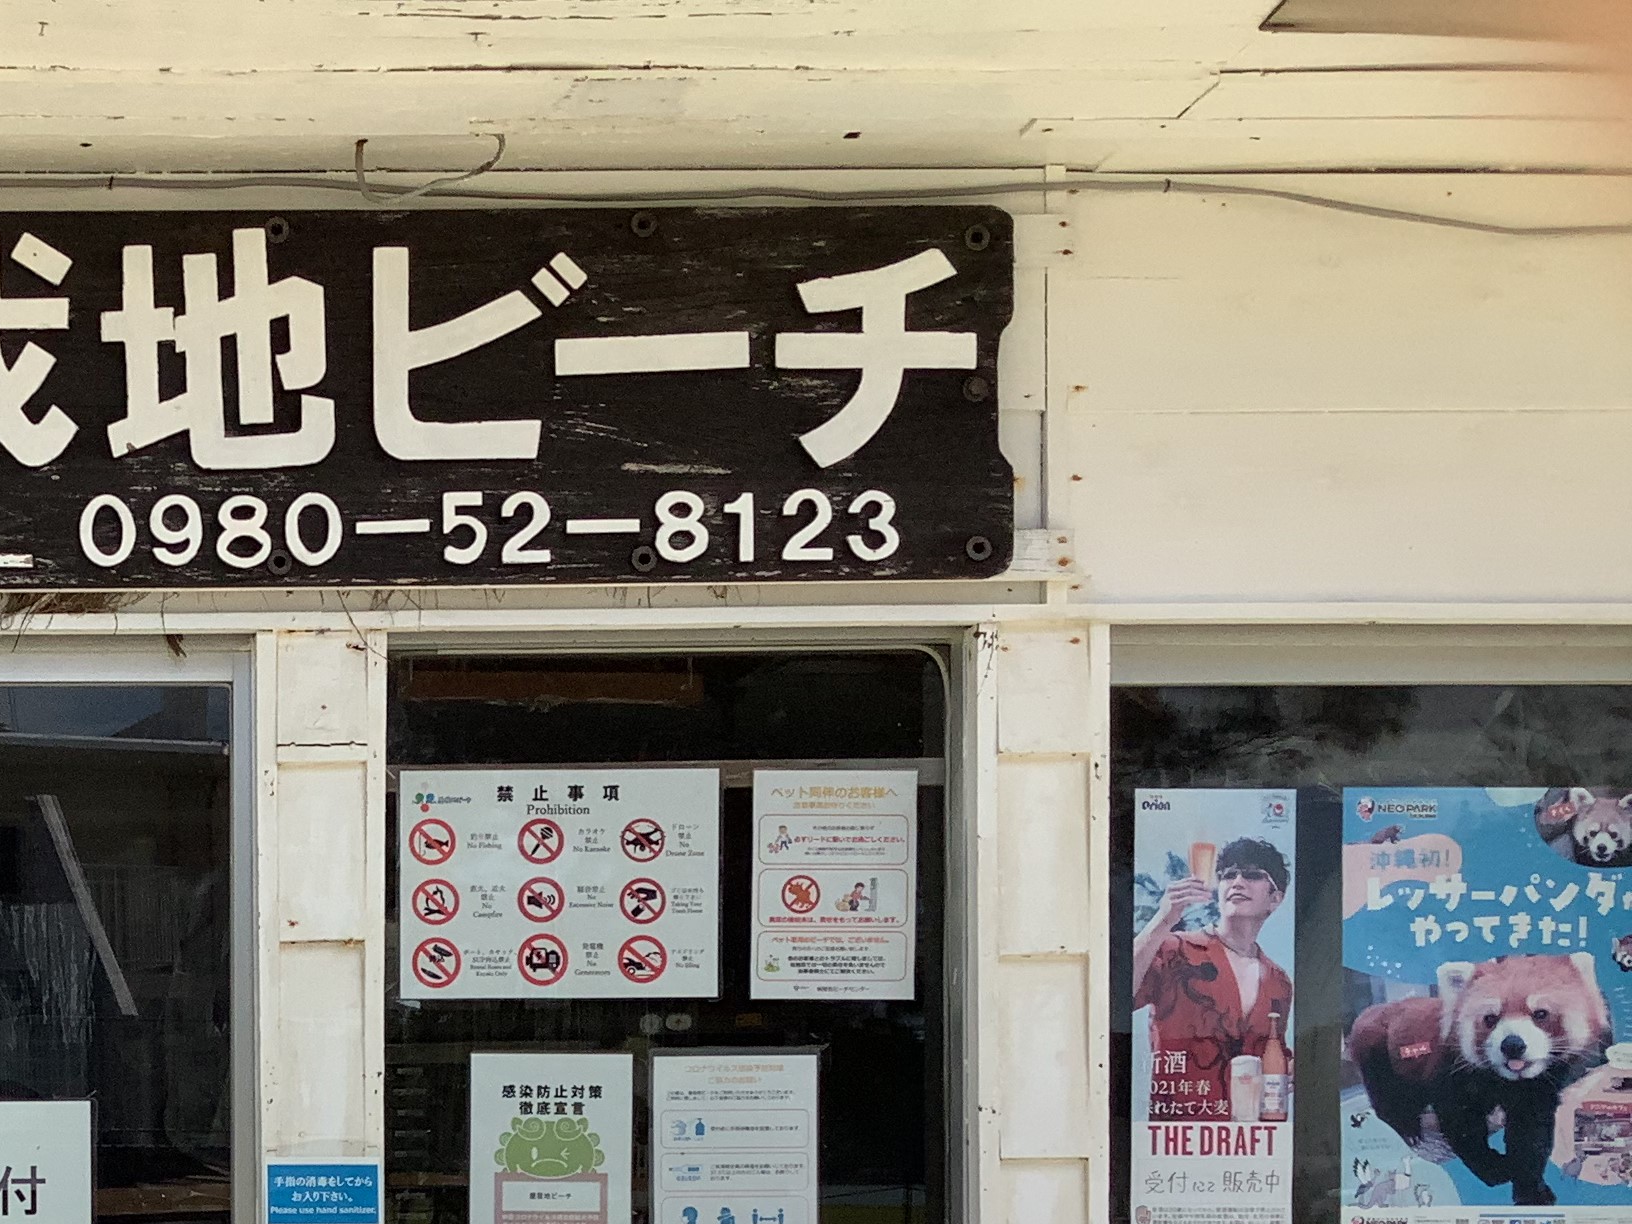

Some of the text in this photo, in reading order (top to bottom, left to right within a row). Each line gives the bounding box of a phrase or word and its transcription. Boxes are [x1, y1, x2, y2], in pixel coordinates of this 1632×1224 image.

[527, 804, 590, 815] Prohibition
[502, 1085, 603, 1099] 感染防止対策
[519, 1101, 586, 1116] 徹底宣言
[1148, 1125, 1277, 1156] THE DRAFT
[274, 1176, 372, 1187] 手指の消毒をしてから
[1222, 1170, 1280, 1194] 販売中
[292, 1191, 353, 1202] お入り下さい。
[270, 1206, 297, 1214] Please
[316, 1206, 337, 1214] hand
